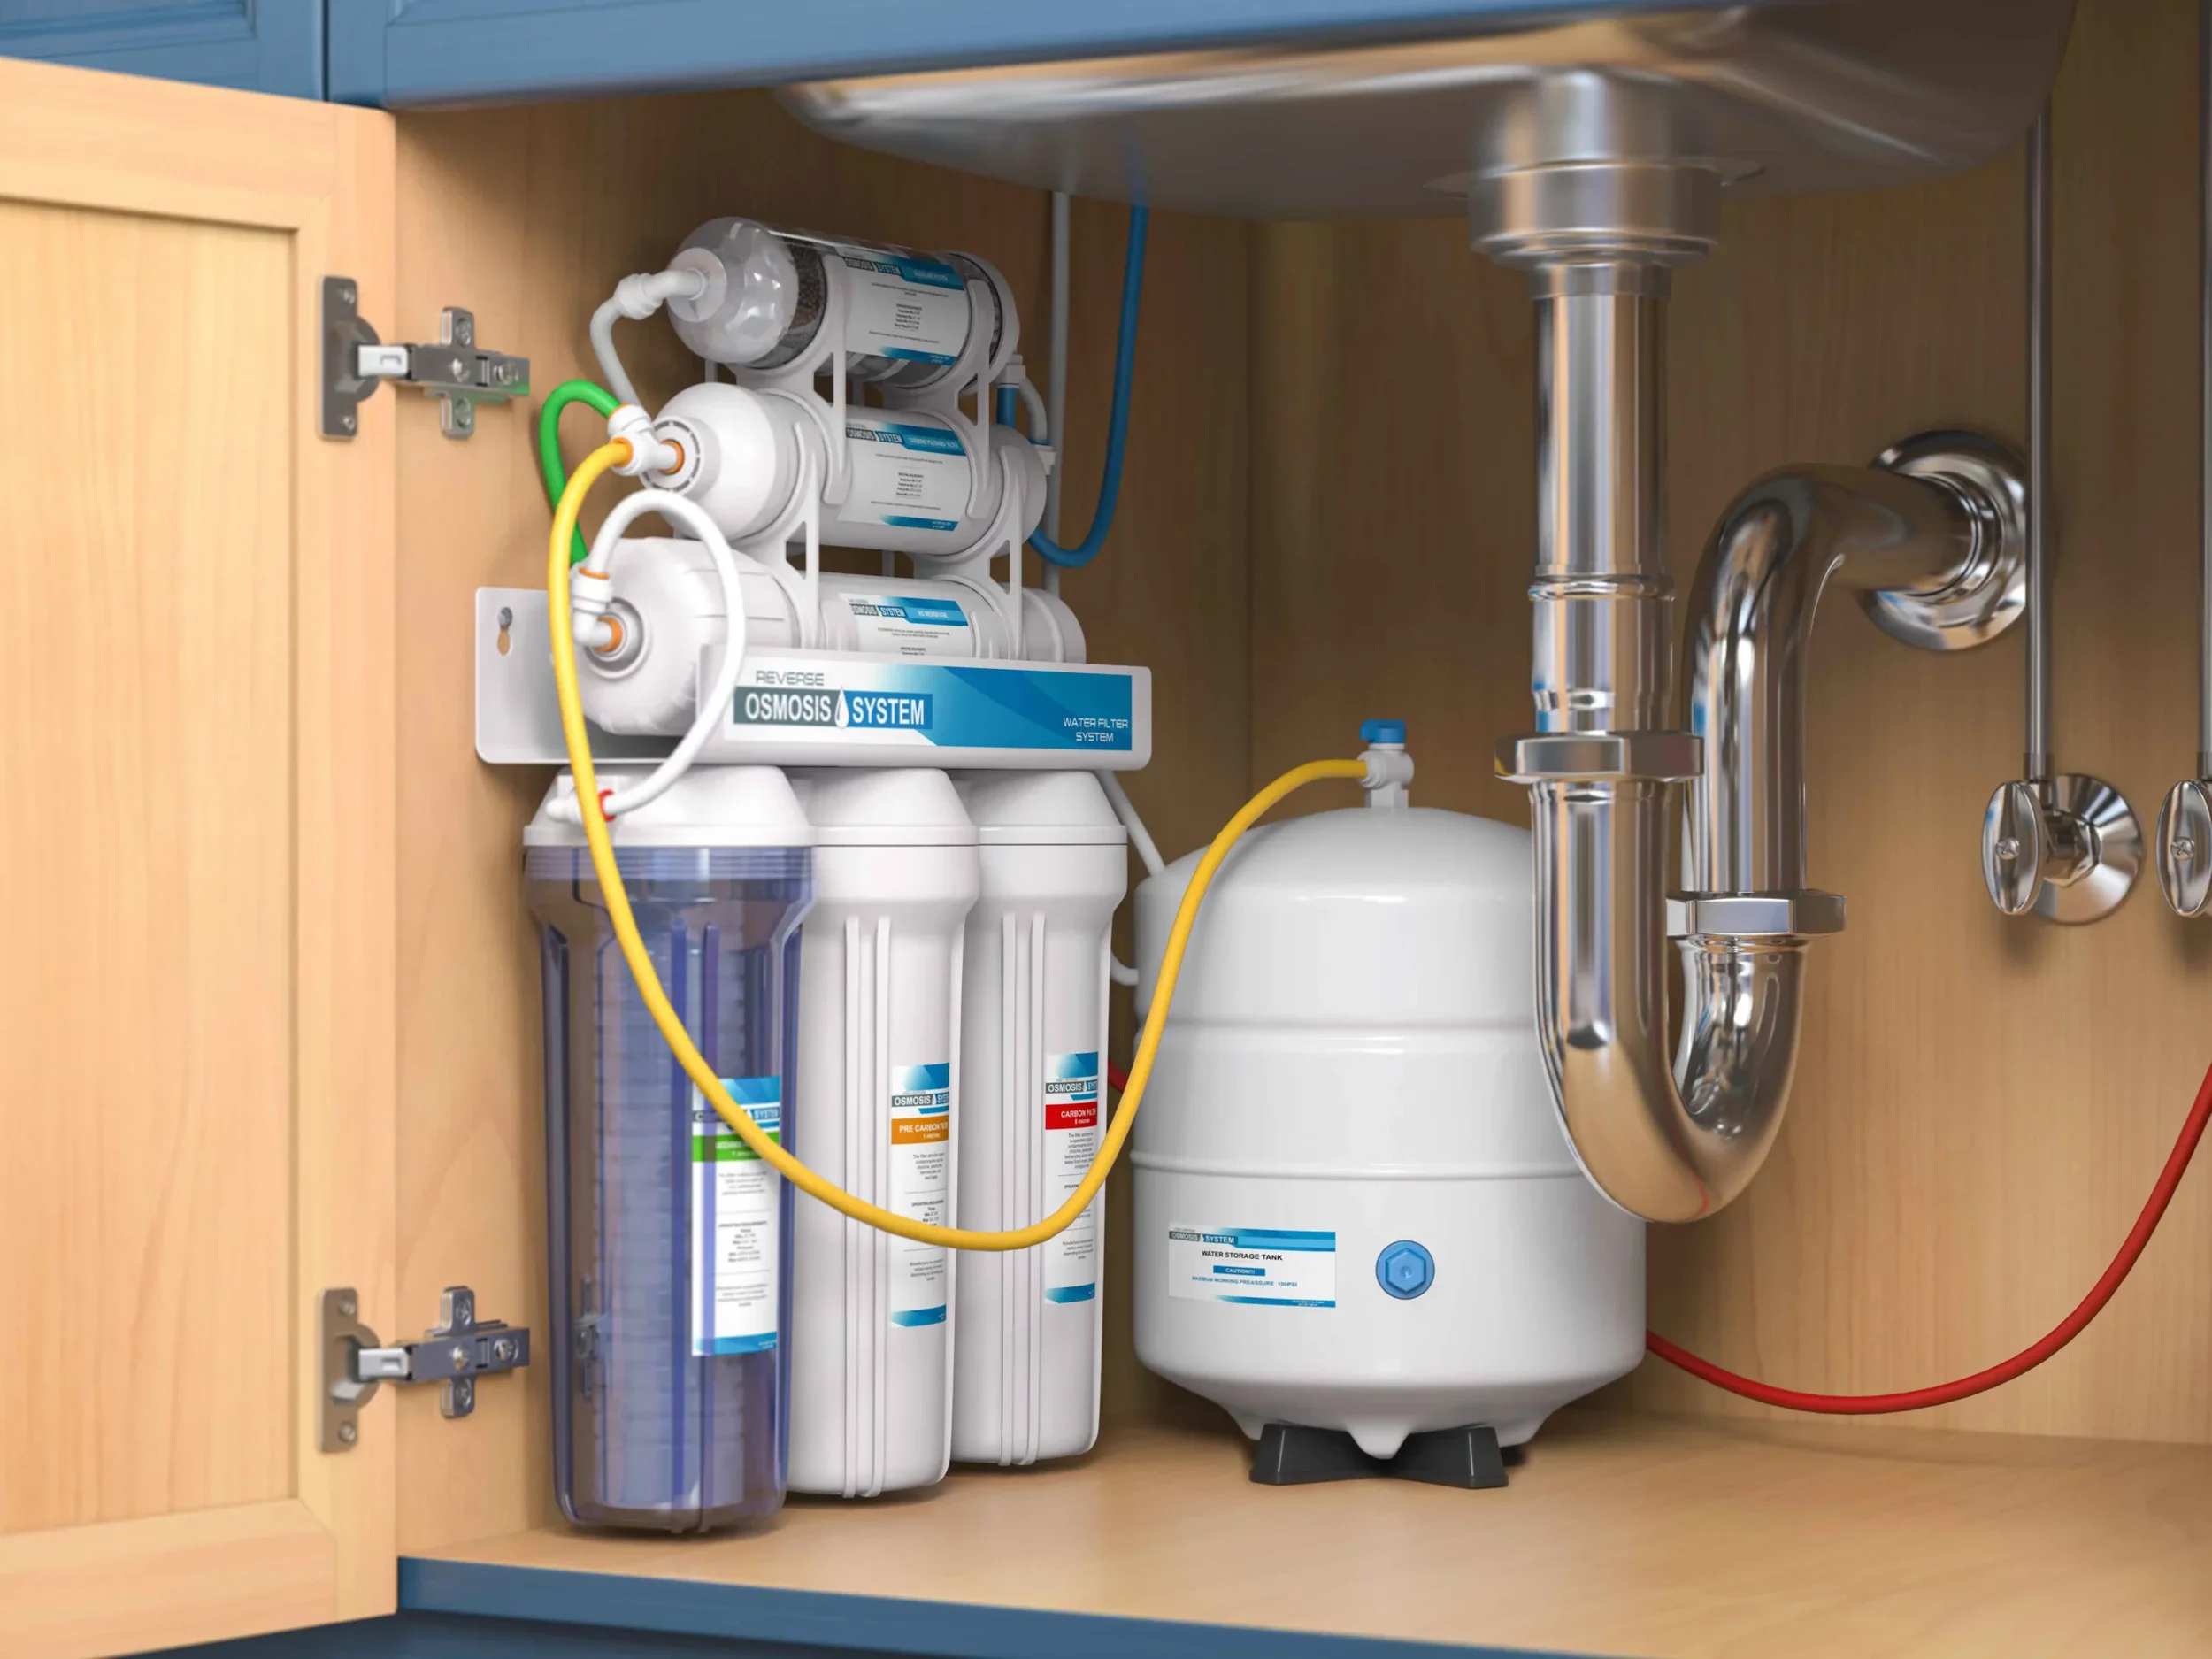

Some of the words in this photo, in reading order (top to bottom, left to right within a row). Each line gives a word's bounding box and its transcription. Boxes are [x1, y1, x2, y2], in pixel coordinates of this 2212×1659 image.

[879, 432, 903, 443] SYSTEM
[881, 606, 906, 617] SYSTEM
[756, 670, 825, 686] REVERSE
[745, 693, 832, 722] OSMOSIS
[852, 696, 925, 725] SYSTEM
[1063, 718, 1096, 728] WATER
[1098, 718, 1128, 728] FILTER
[1076, 732, 1114, 742] SYSTEM
[1048, 1083, 1082, 1093] OSMOSIS
[894, 1095, 931, 1106] OSMOSIS
[1061, 1109, 1086, 1118] CARBON
[915, 1123, 940, 1132] CARBON
[1171, 1232, 1199, 1241] OSMOSIS
[1204, 1234, 1235, 1244] SYSTEM
[1225, 1251, 1260, 1260] STORAGE
